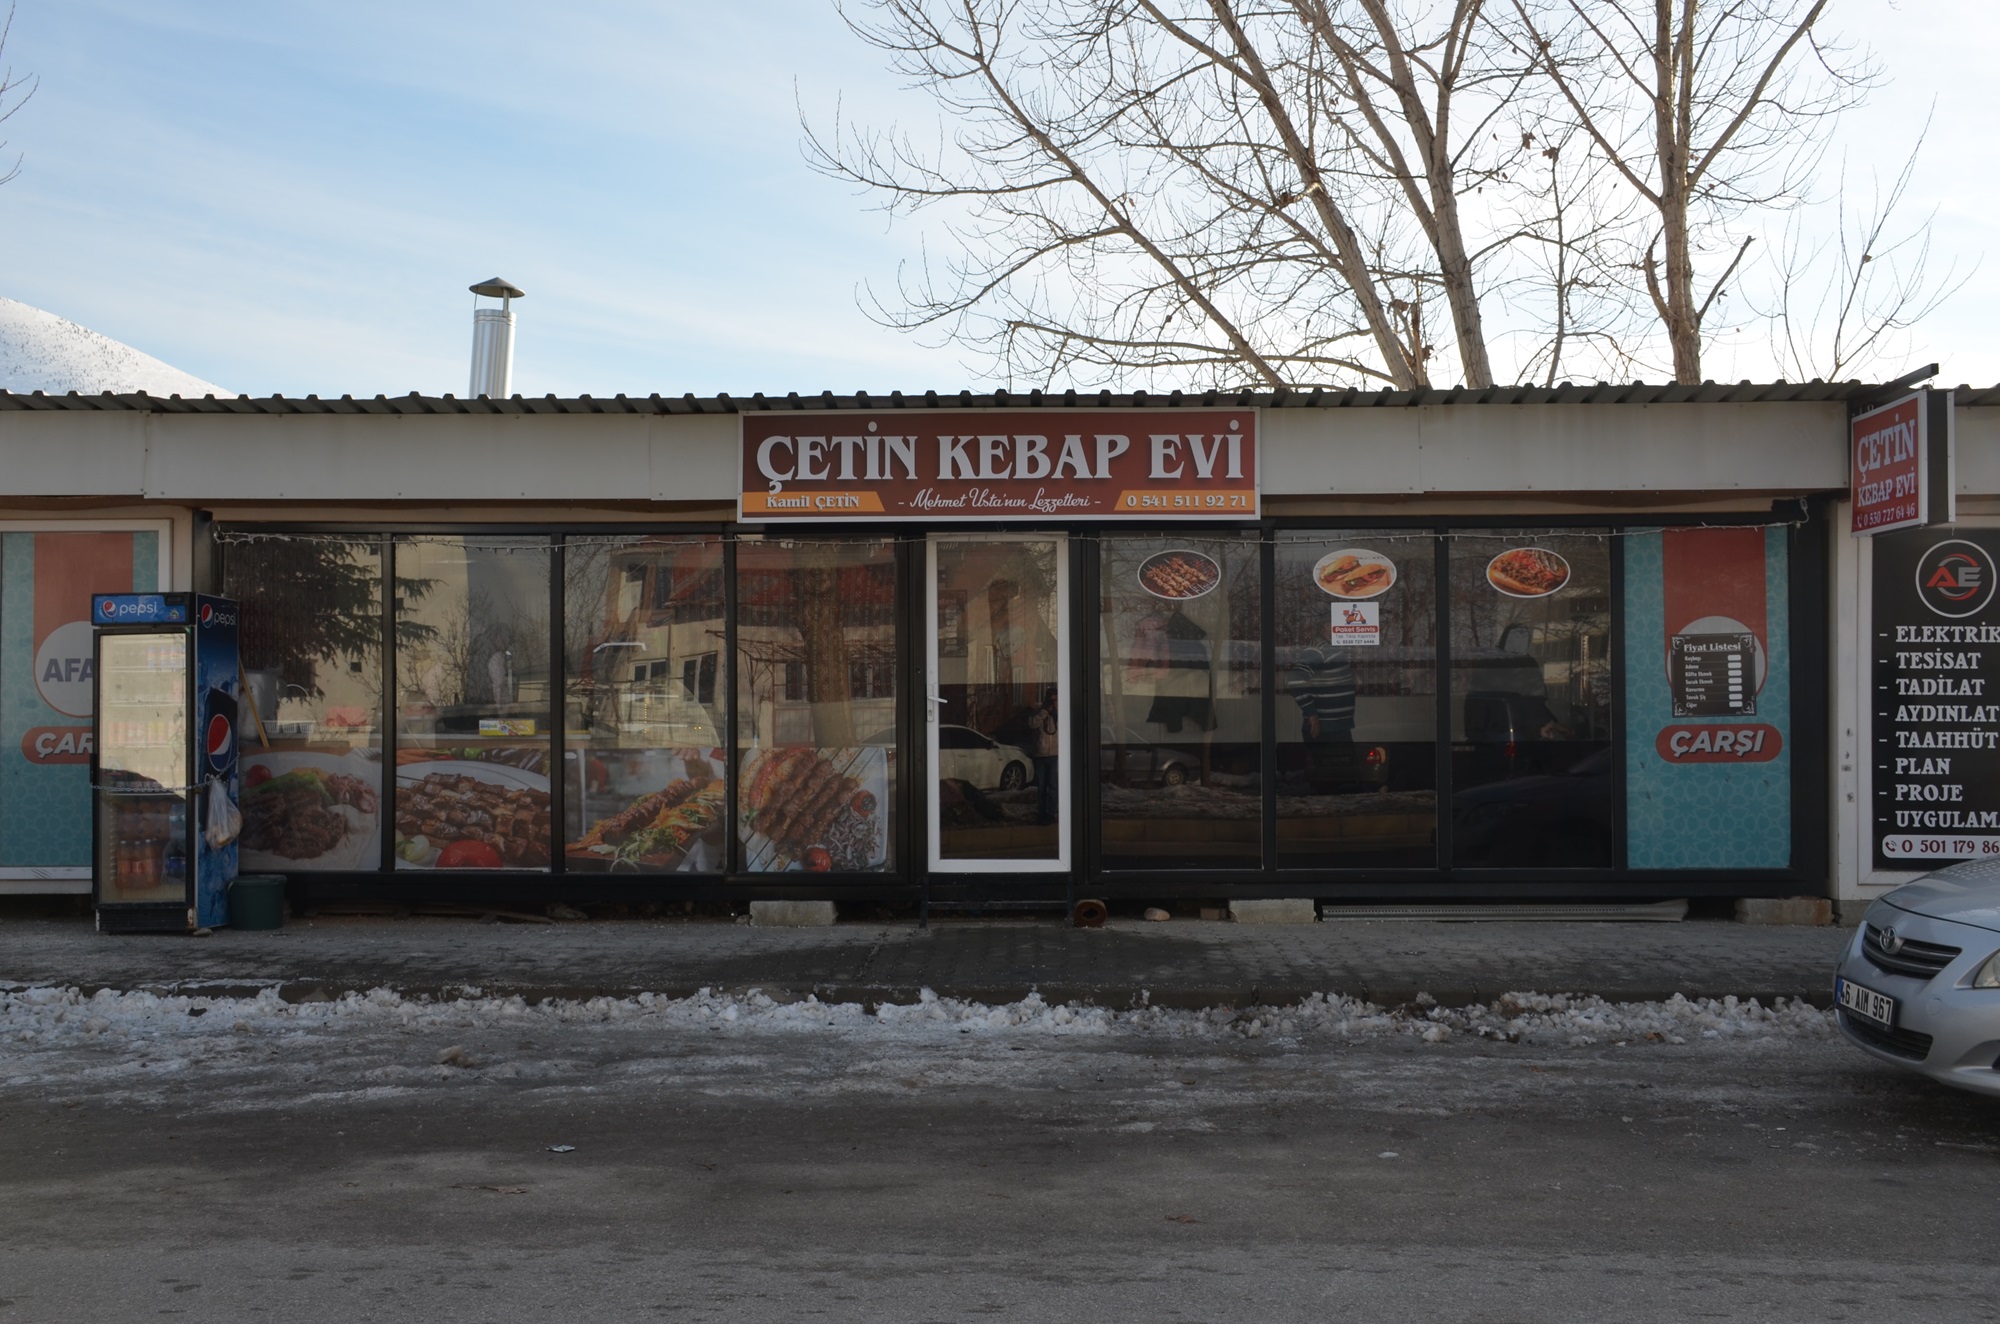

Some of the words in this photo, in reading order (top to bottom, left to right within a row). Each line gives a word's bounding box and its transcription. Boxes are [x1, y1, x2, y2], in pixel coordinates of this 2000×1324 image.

[757, 421, 918, 495] ÇETİN
[937, 435, 1130, 480] KEBAP
[1148, 419, 1244, 479] EVİ
[1857, 413, 1915, 484] ÇETİN
[1857, 479, 1893, 507] KEBAP
[1895, 466, 1915, 498] EVİ
[767, 495, 810, 508] Kamil
[815, 493, 860, 511] ÇETİN
[910, 488, 967, 511] Mehmet
[969, 488, 1028, 508] Usta'nın
[1028, 487, 1091, 513] Lezzetleri
[1126, 494, 1138, 507] 0
[1141, 494, 1168, 508] 541
[1173, 495, 1200, 508] 511
[1205, 495, 1226, 508] 92
[1230, 495, 1247, 508] 71
[1863, 514, 1869, 526] 0
[1882, 508, 1895, 522] 727
[1895, 506, 1905, 519] 64
[1906, 503, 1916, 517] 46
[1926, 566, 1982, 588] AE
[119, 601, 158, 617] pepsi
[213, 612, 237, 627] pepsi
[1895, 621, 2000, 643] ELEKTRİK
[1684, 644, 1707, 653] Fiyat
[1710, 643, 1742, 652] Listesi
[1895, 648, 1982, 669] TESİSAT
[1895, 674, 1986, 696] TADİLAT
[1895, 705, 2000, 722] AYDINLAT
[1670, 730, 1766, 758] ÇARŞI
[1895, 727, 1999, 749] TAAHHÜT
[1895, 757, 1951, 775] PLAN
[1895, 784, 1963, 801] PROJE
[1895, 810, 2000, 828] UYGULAM
[1901, 839, 1914, 853] 0
[1919, 839, 1947, 854] 501
[1952, 840, 1975, 854] 179
[1982, 841, 2000, 854] 86
[1855, 988, 1870, 1014] AIM
[1872, 995, 1892, 1023] 967
